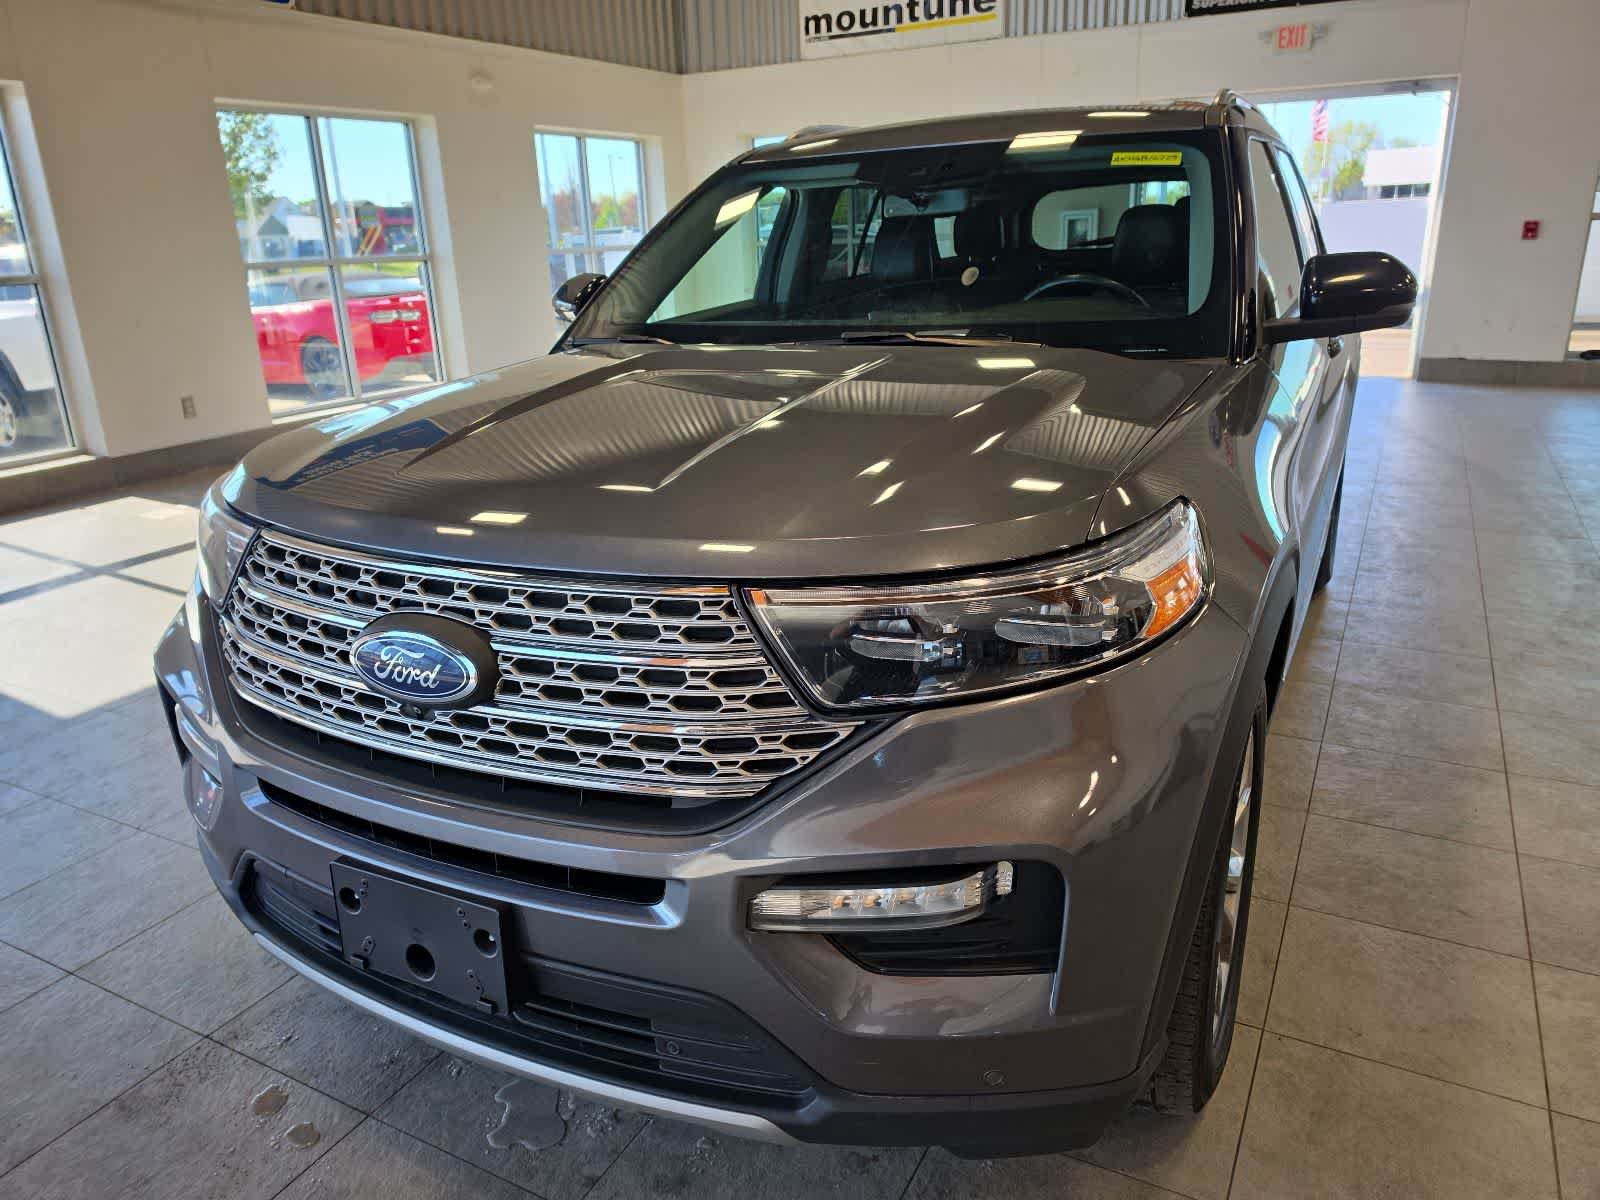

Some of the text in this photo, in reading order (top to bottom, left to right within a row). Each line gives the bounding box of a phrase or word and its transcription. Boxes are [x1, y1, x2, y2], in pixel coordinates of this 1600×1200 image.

[804, 0, 996, 36] mountune
[1279, 24, 1307, 49] EXIT
[374, 645, 442, 689] Ford
